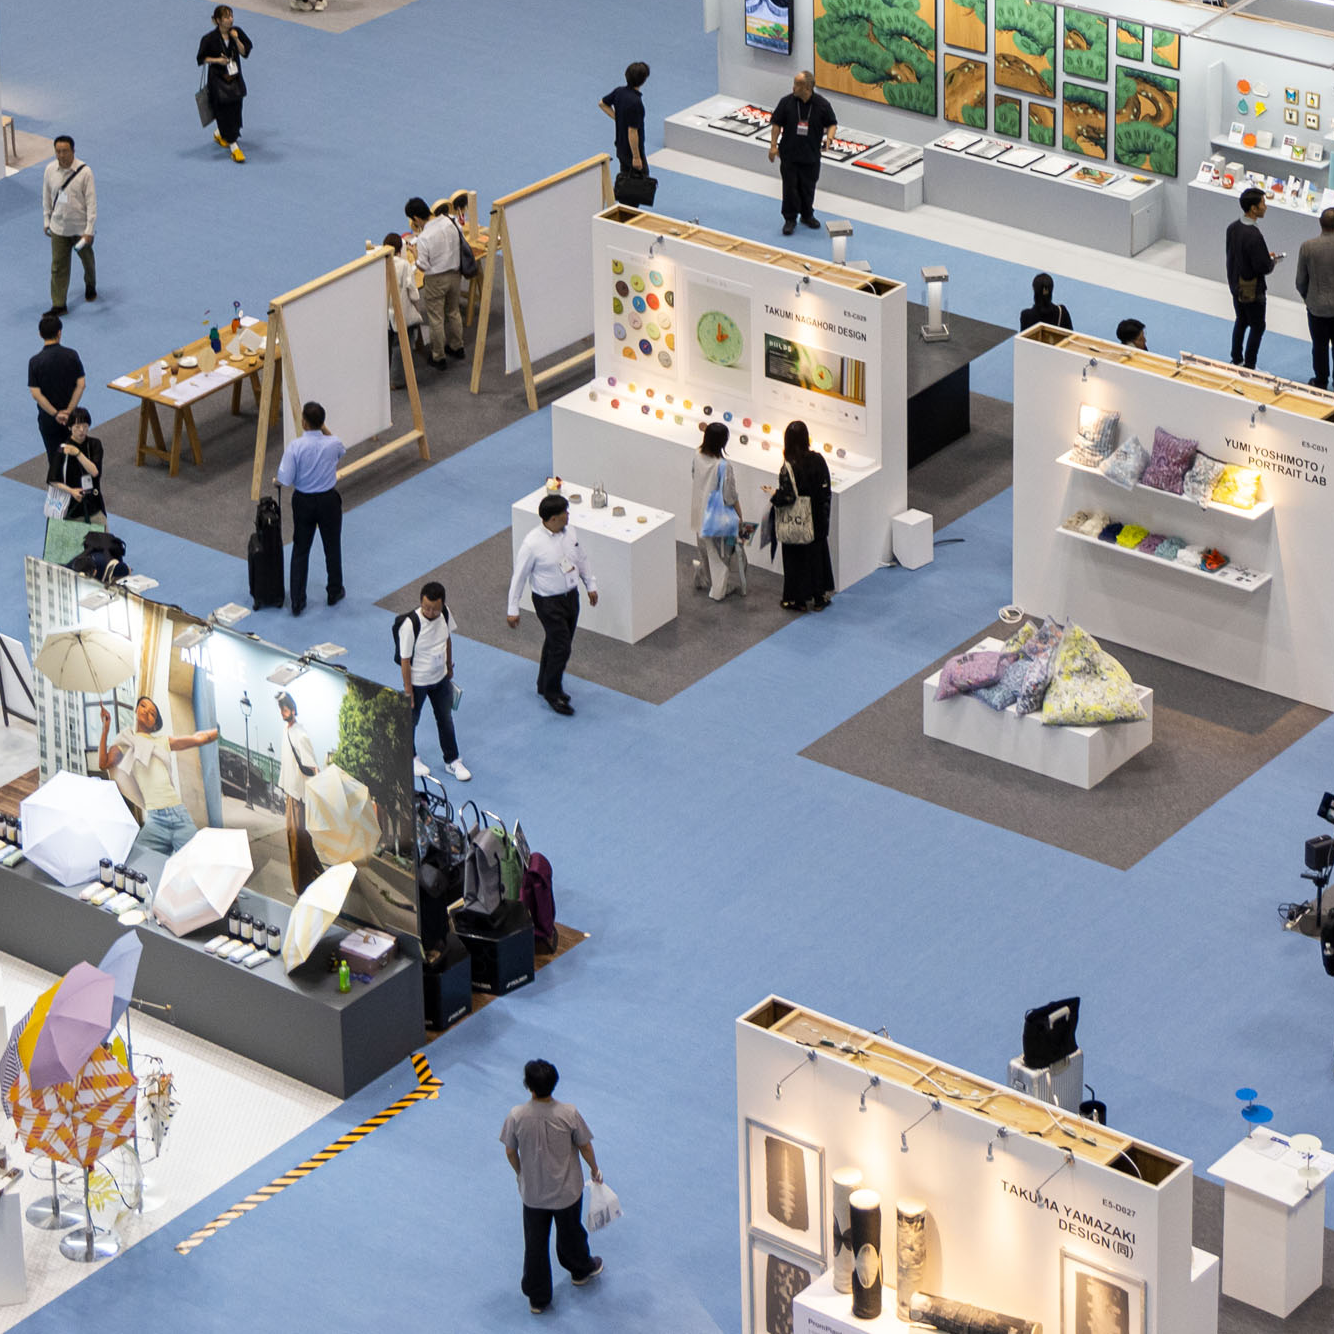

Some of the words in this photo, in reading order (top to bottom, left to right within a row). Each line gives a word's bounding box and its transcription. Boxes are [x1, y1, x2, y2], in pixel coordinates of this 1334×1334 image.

[764, 304, 793, 321] TAKUMI
[795, 314, 836, 333] NAGAHORI
[837, 326, 867, 343] DESIGN
[1224, 437, 1251, 453] YUMI
[1254, 445, 1319, 472] YOSHIMOTO
[1301, 440, 1328, 454] E5-C031
[1248, 456, 1302, 479] PORTRAIT
[1305, 472, 1328, 487] LAB
[1063, 1204, 1136, 1245] YAMAZAKI
[1102, 1198, 1136, 1218] E5-D027
